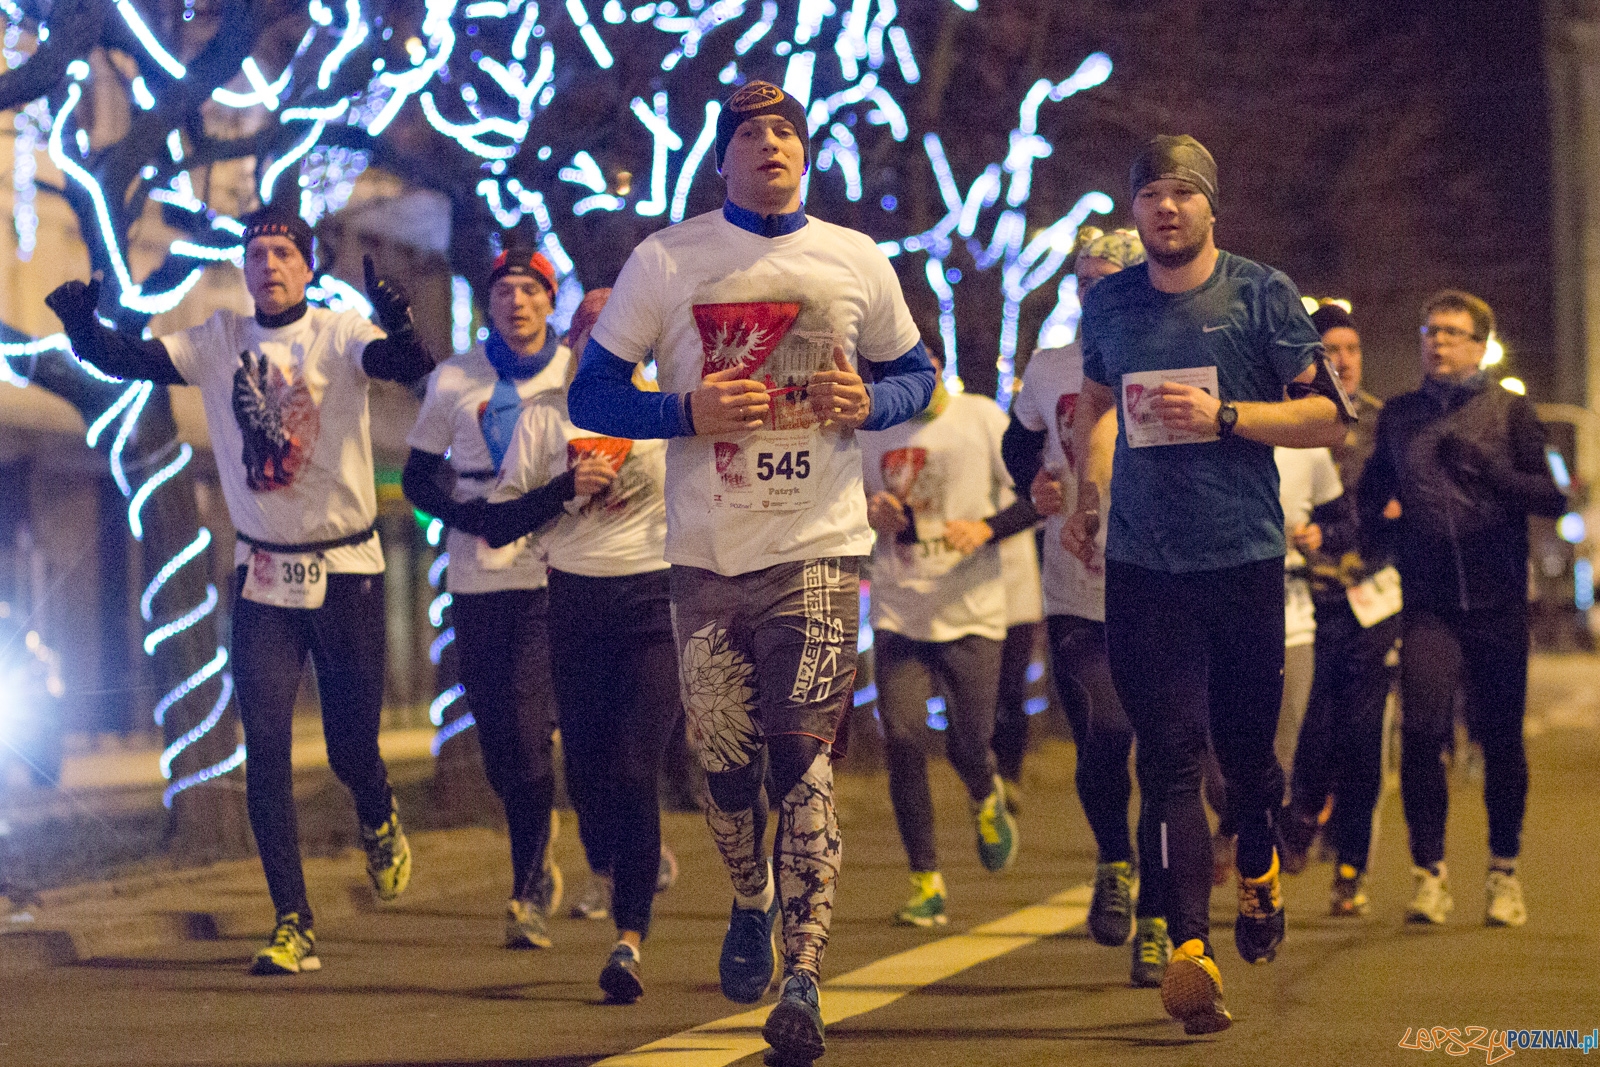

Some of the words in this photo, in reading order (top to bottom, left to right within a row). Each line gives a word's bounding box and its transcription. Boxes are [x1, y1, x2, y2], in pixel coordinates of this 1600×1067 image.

[757, 451, 810, 481] 545
[768, 487, 800, 496] Patryk
[282, 562, 320, 584] 399
